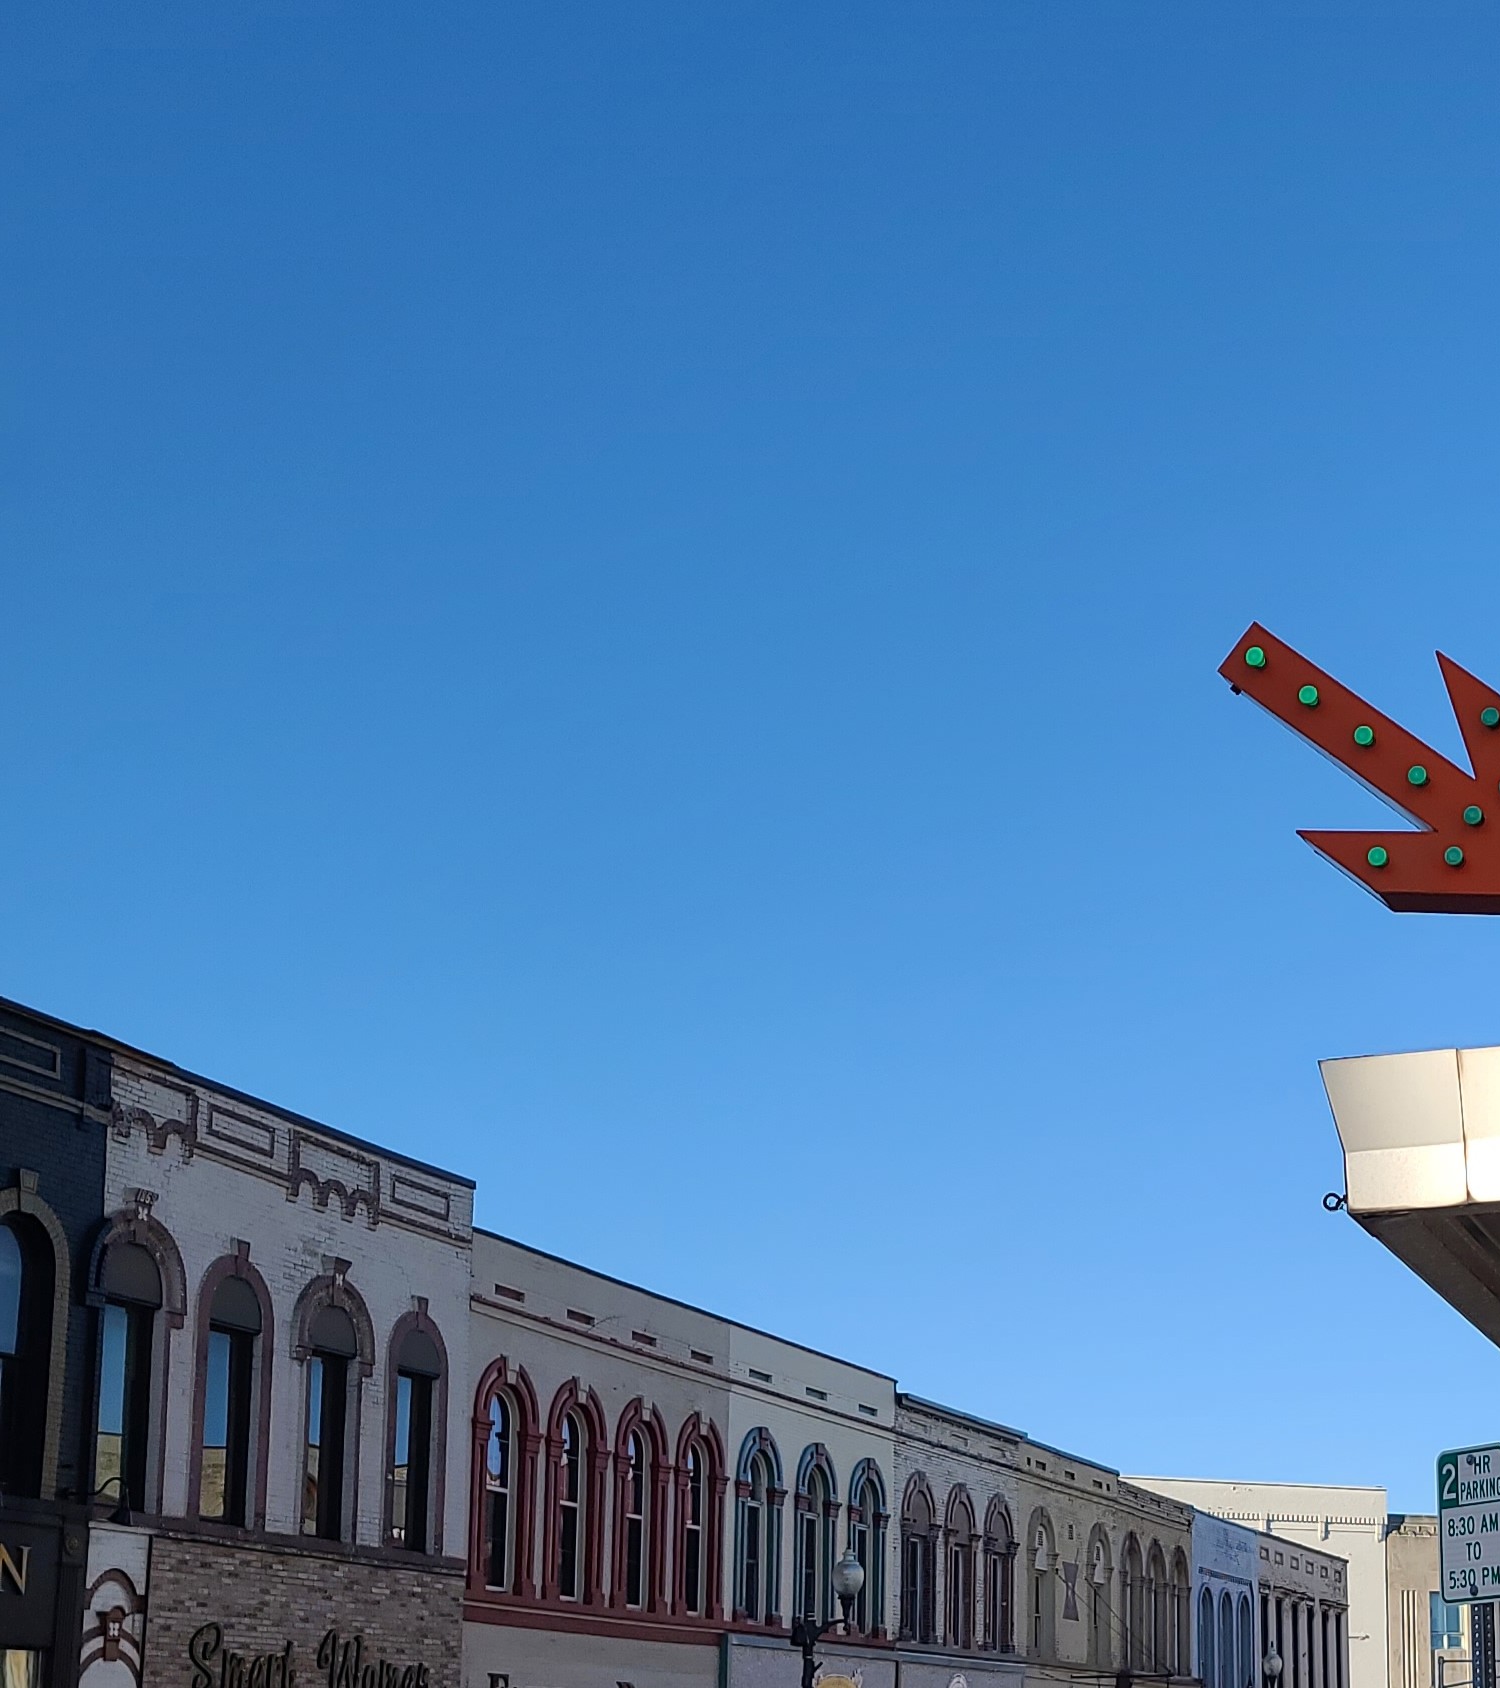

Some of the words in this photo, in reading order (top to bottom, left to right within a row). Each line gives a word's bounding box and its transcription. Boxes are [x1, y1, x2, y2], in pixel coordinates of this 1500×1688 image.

[1473, 1455, 1491, 1475] HR
[1442, 1463, 1457, 1500] 2
[1448, 1515, 1475, 1537] 8:30
[1481, 1513, 1499, 1534] AM
[1466, 1541, 1482, 1561] TO
[1449, 1568, 1476, 1589] 5:30
[1482, 1566, 1500, 1586] PM
